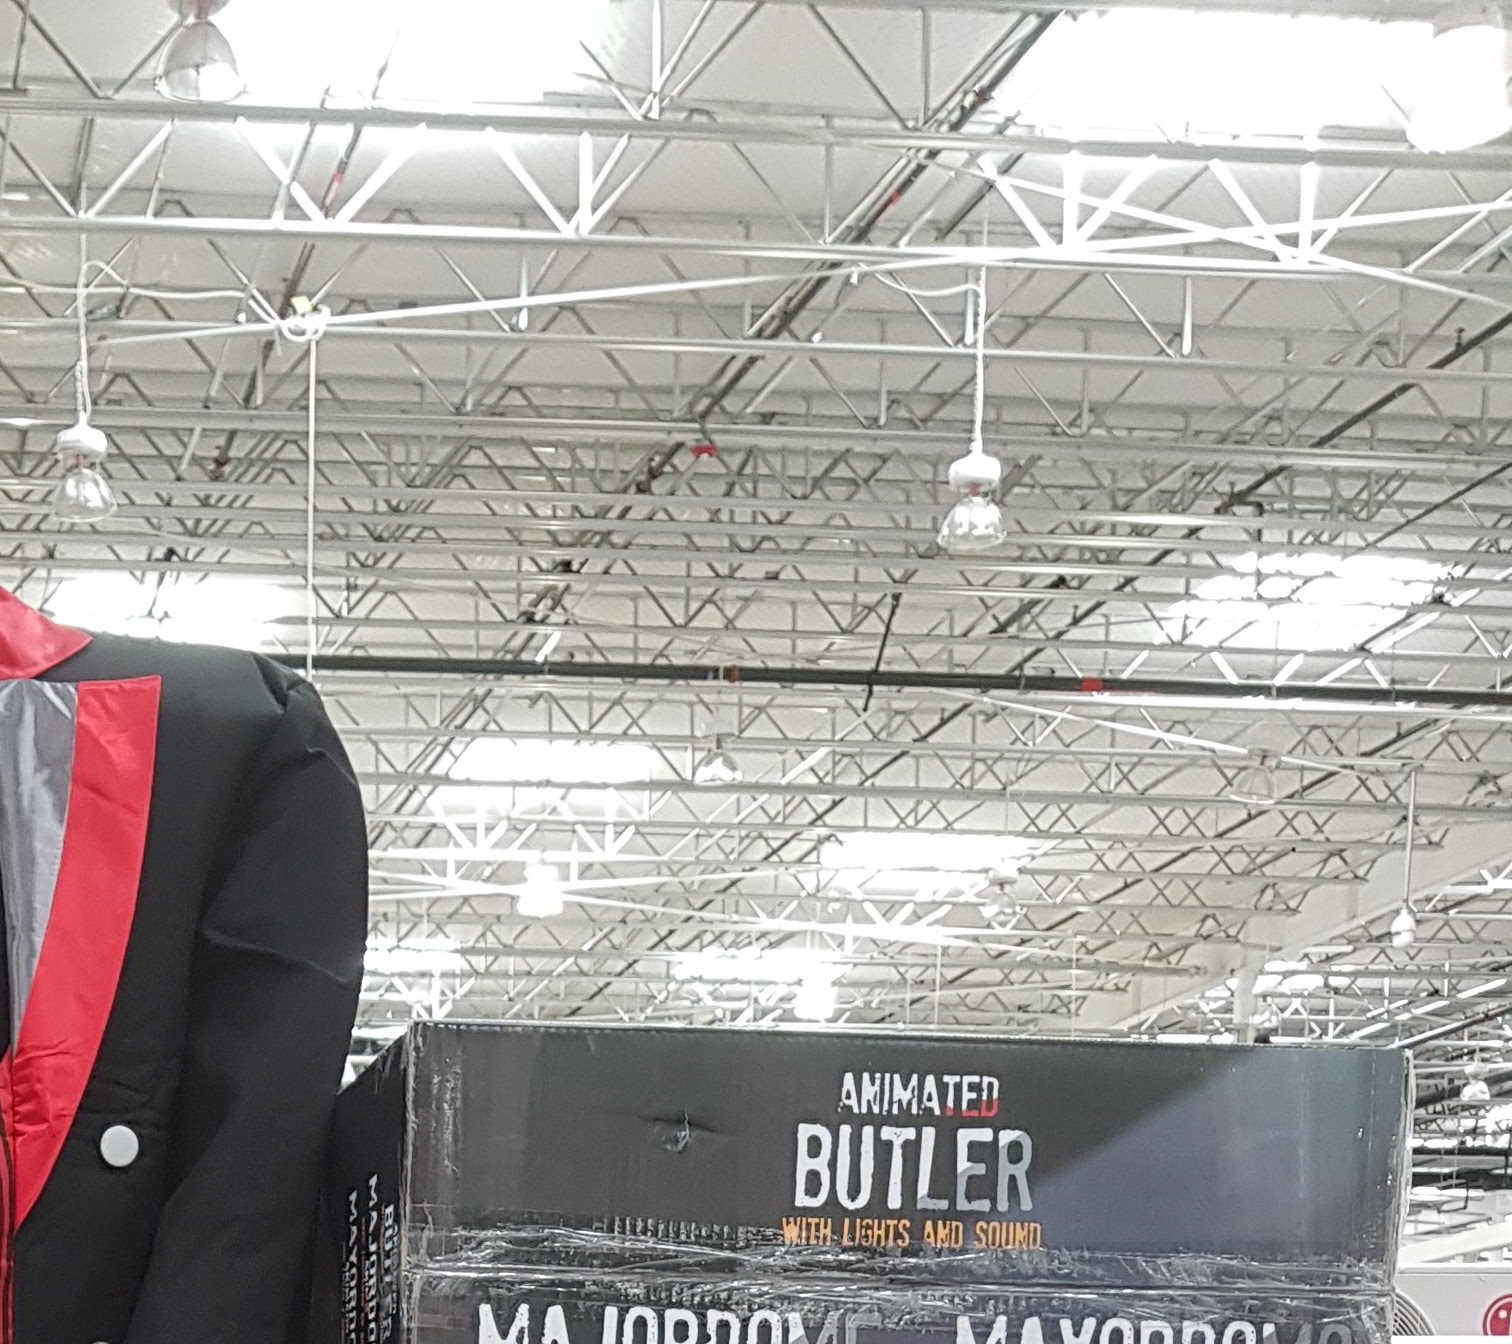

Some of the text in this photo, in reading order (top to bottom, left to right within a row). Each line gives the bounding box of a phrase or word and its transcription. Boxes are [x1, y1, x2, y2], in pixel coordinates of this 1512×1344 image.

[838, 1073, 999, 1115] ANIMATED
[795, 1123, 1034, 1212] BUTLER
[782, 1217, 1041, 1249] WITH LIGHTS AND SOUND
